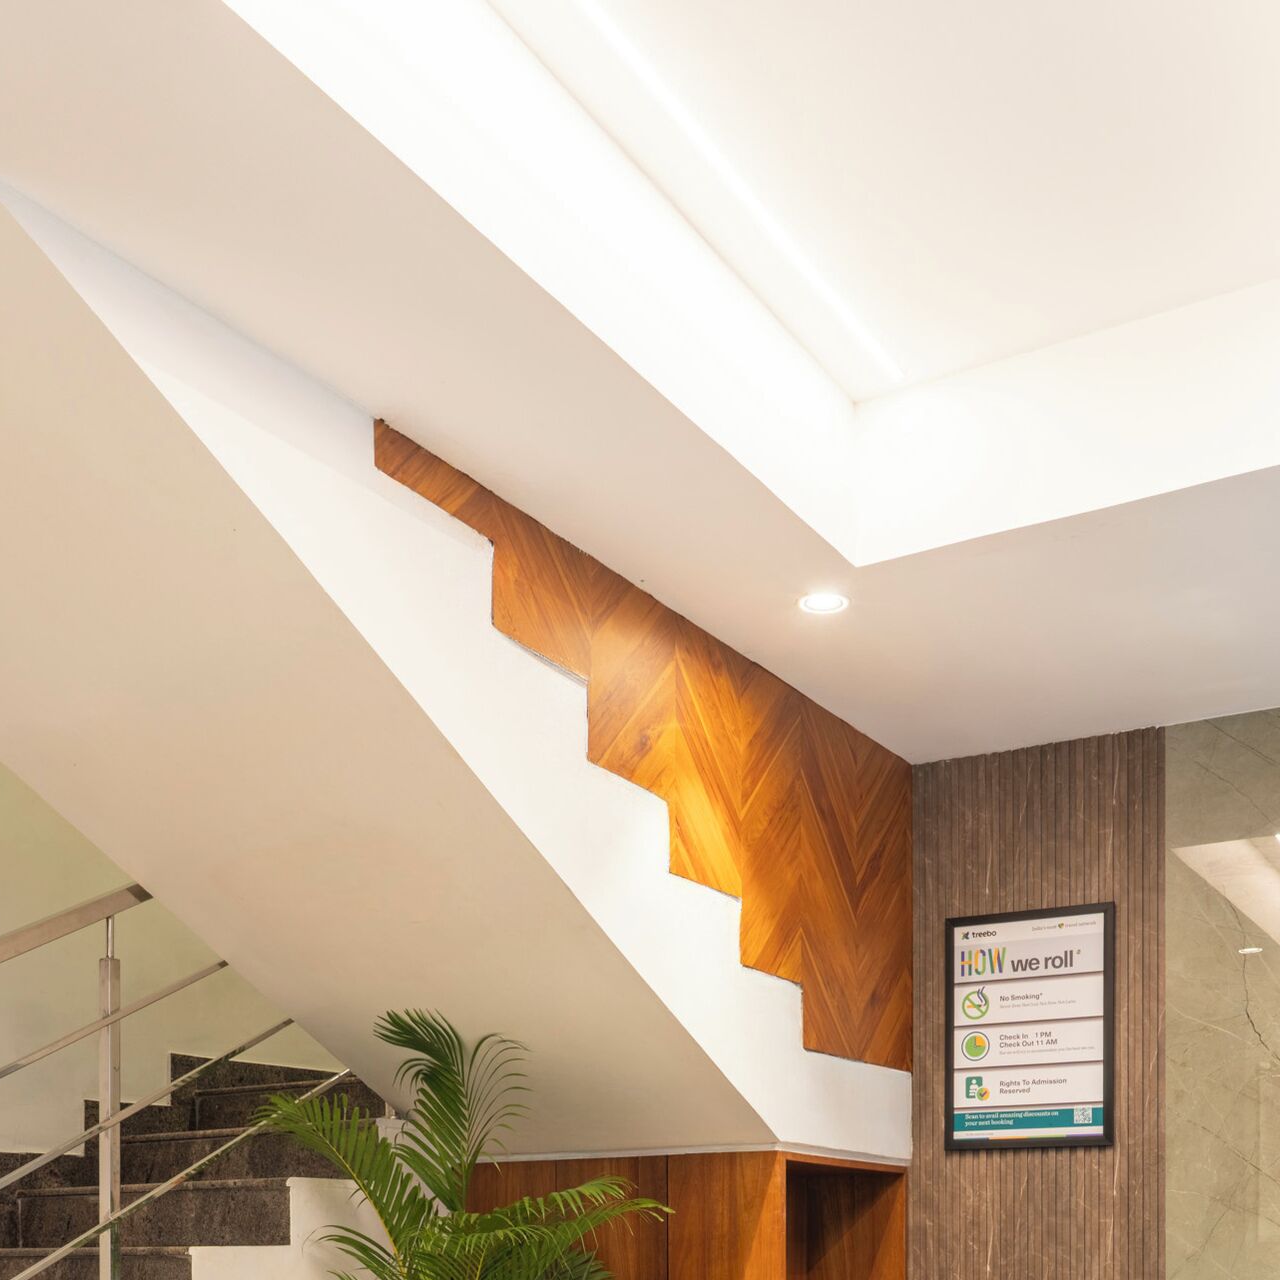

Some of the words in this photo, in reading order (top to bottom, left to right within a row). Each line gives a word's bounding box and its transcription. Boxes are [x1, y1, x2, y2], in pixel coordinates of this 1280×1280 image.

[972, 930, 997, 939] treebo
[961, 947, 1006, 977] HOW
[1011, 957, 1040, 972] we
[1044, 950, 1073, 969] roll
[999, 1041, 1020, 1049] Check
[1000, 1080, 1021, 1088] Rights
[1031, 1078, 1067, 1086] Admission
[1000, 1087, 1030, 1095] Reserved
